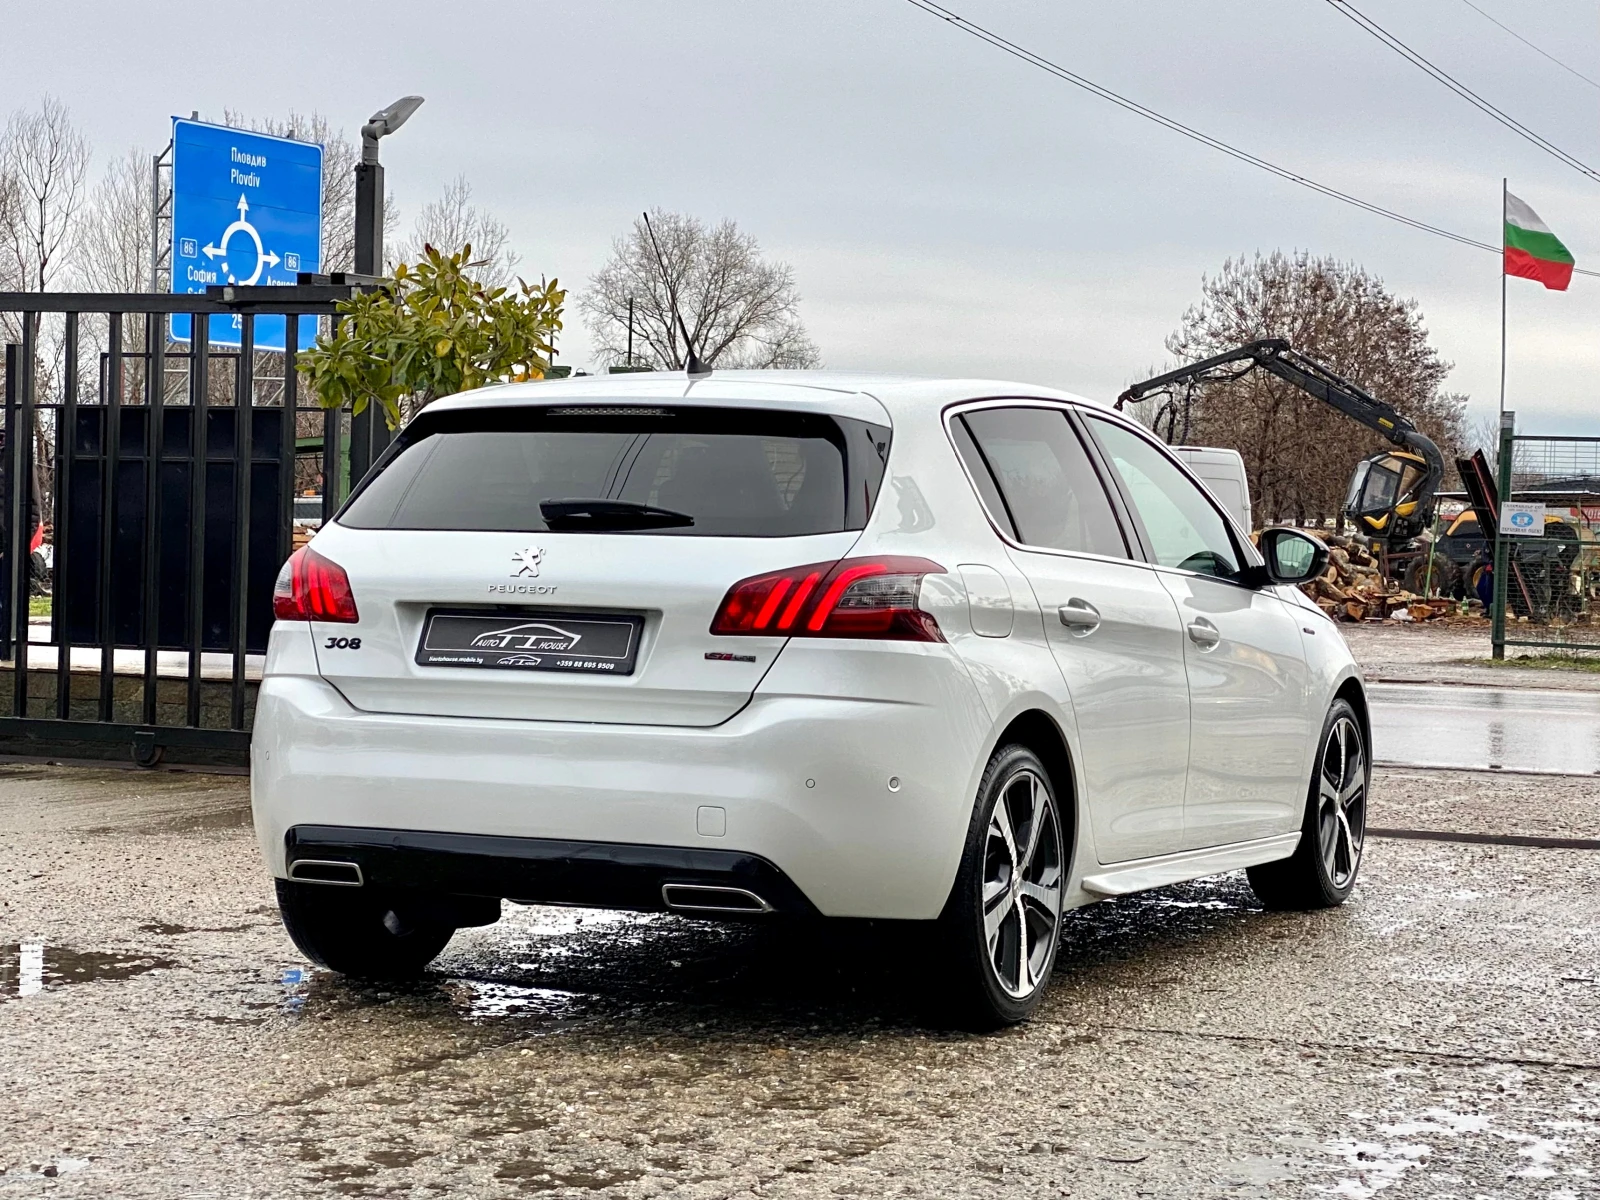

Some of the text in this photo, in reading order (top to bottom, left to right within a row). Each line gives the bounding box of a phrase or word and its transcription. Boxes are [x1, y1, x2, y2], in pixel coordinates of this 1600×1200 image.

[231, 147, 267, 167] Пловдив
[230, 168, 260, 187] Plovdiv
[184, 241, 194, 255] 86
[287, 255, 297, 269] 86
[187, 265, 217, 284] София
[487, 584, 558, 595] PEUGEOT
[324, 637, 362, 650] 308
[476, 639, 499, 647] AUTO
[537, 641, 570, 650] HOUSE
[556, 660, 573, 668] +359
[597, 662, 615, 670] 9509
